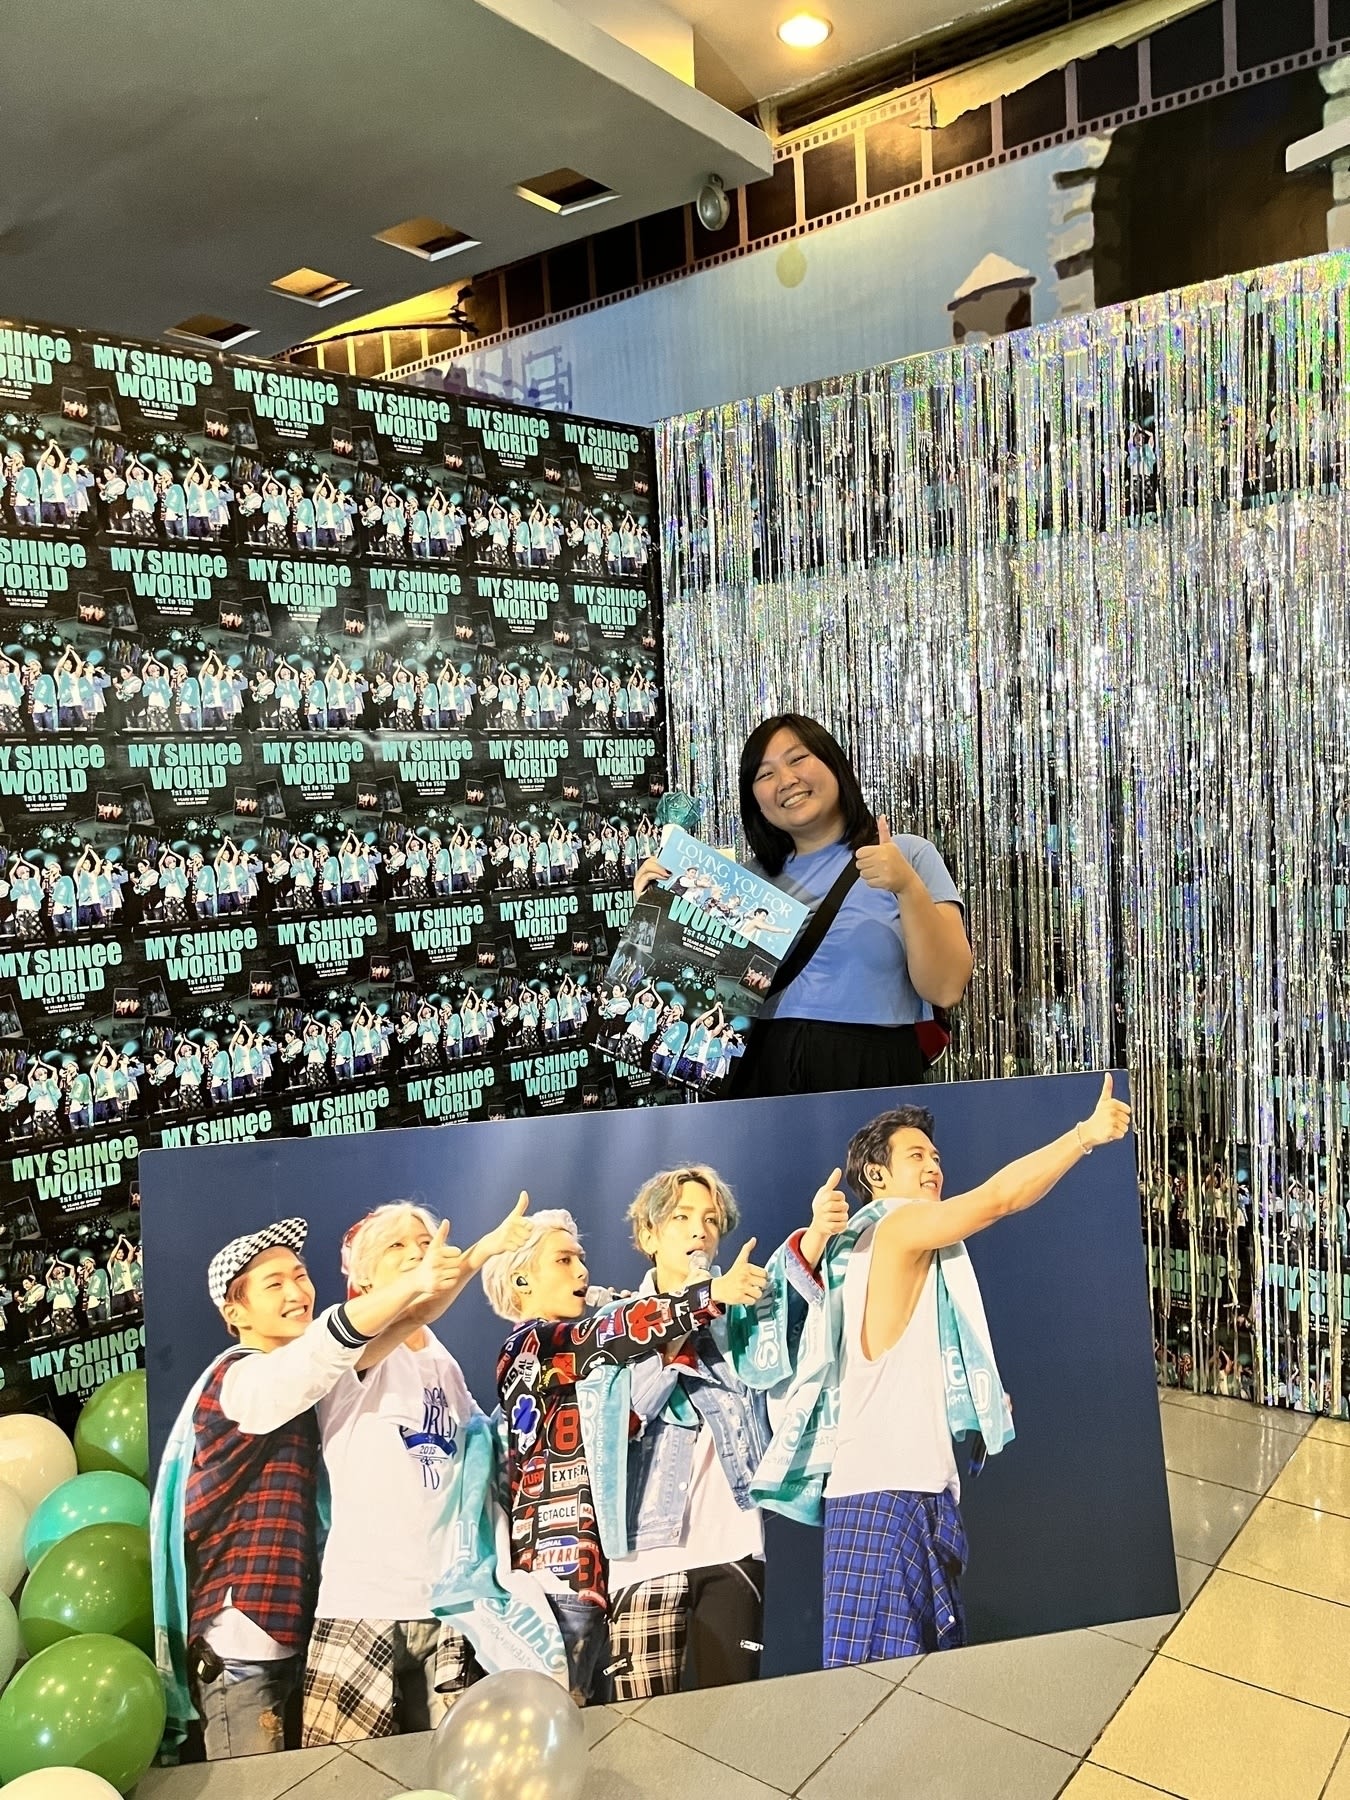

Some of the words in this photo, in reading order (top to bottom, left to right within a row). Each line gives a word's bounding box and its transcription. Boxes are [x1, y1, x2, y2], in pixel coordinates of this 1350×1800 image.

[93, 343, 127, 372] MY
[130, 349, 212, 385] SHINee
[115, 371, 195, 406] WORLD
[234, 367, 264, 393] MY
[267, 373, 338, 406] SHINee
[253, 393, 324, 425] WORLD
[357, 388, 384, 412] MY
[386, 393, 450, 423] SHINee
[374, 412, 437, 441] WORLD
[466, 406, 490, 429] MY
[492, 410, 549, 439] SHINee
[482, 429, 537, 456] WORLD
[564, 423, 585, 444] MY
[587, 426, 638, 453] SHINee
[578, 444, 628, 469] WORLD
[110, 547, 144, 572] MY
[147, 549, 227, 578] SHINee
[248, 558, 278, 581] MY
[280, 560, 351, 587] SHINee
[1, 563, 68, 591] ORLD
[132, 572, 211, 599] WORLD
[369, 568, 396, 590] MY
[398, 570, 460, 594] SHINee
[477, 577, 501, 597] MY
[503, 578, 558, 601] SHINee
[267, 582, 337, 607] WORLD
[386, 590, 448, 614] WORLD
[573, 585, 594, 604] MY
[596, 586, 646, 608] SHINee
[492, 598, 547, 620] WORLD
[587, 605, 636, 625] WORLD
[15, 744, 104, 769] SHINee
[128, 744, 161, 767] MY
[164, 742, 242, 766] SHINee
[262, 742, 291, 764] MY
[294, 741, 363, 763] SHINee
[382, 741, 408, 761] MY
[410, 740, 472, 761] SHINee
[488, 740, 511, 759] MY
[513, 739, 568, 759] SHINee
[582, 739, 603, 757] MY
[605, 738, 654, 757] SHINee
[149, 766, 226, 789] WORLD
[281, 763, 349, 785] WORLD
[399, 760, 459, 781] WORLD
[503, 758, 557, 778] WORLD
[596, 757, 644, 775] WORLD
[0, 769, 87, 794] WORLD
[676, 838, 731, 878] LOVING
[730, 870, 764, 898] YOU
[762, 891, 793, 918] FOR
[499, 900, 522, 921] MY
[524, 895, 578, 918] SHINee
[592, 891, 612, 911] MY
[277, 921, 306, 945] MY
[309, 914, 377, 942] SHINee
[395, 910, 420, 932] MY
[422, 904, 483, 929] SHINee
[514, 915, 567, 939] WORLD
[144, 935, 177, 960] MY
[180, 927, 257, 956] SHINee
[296, 937, 363, 964] WORLD
[411, 925, 471, 950] WORLD
[0, 951, 30, 978] MY
[34, 941, 122, 973] SHINee
[165, 951, 241, 980] WORLD
[17, 967, 104, 999] WORLD
[510, 1059, 532, 1081] MY
[534, 1048, 588, 1076] SHINee
[407, 1078, 432, 1102] MY
[434, 1066, 494, 1096] SHINee
[524, 1069, 577, 1097] WORLD
[291, 1099, 319, 1125] MY
[322, 1086, 389, 1119] SHINee
[423, 1089, 482, 1118] WORLD
[160, 1124, 193, 1149] MY
[196, 1110, 272, 1145] SHINee
[309, 1110, 375, 1136] WORLD
[12, 1152, 48, 1182] MY
[52, 1135, 138, 1173] SHINee
[35, 1162, 121, 1200] WORLD
[30, 1347, 65, 1380] MY
[53, 1351, 136, 1396] WORLD
